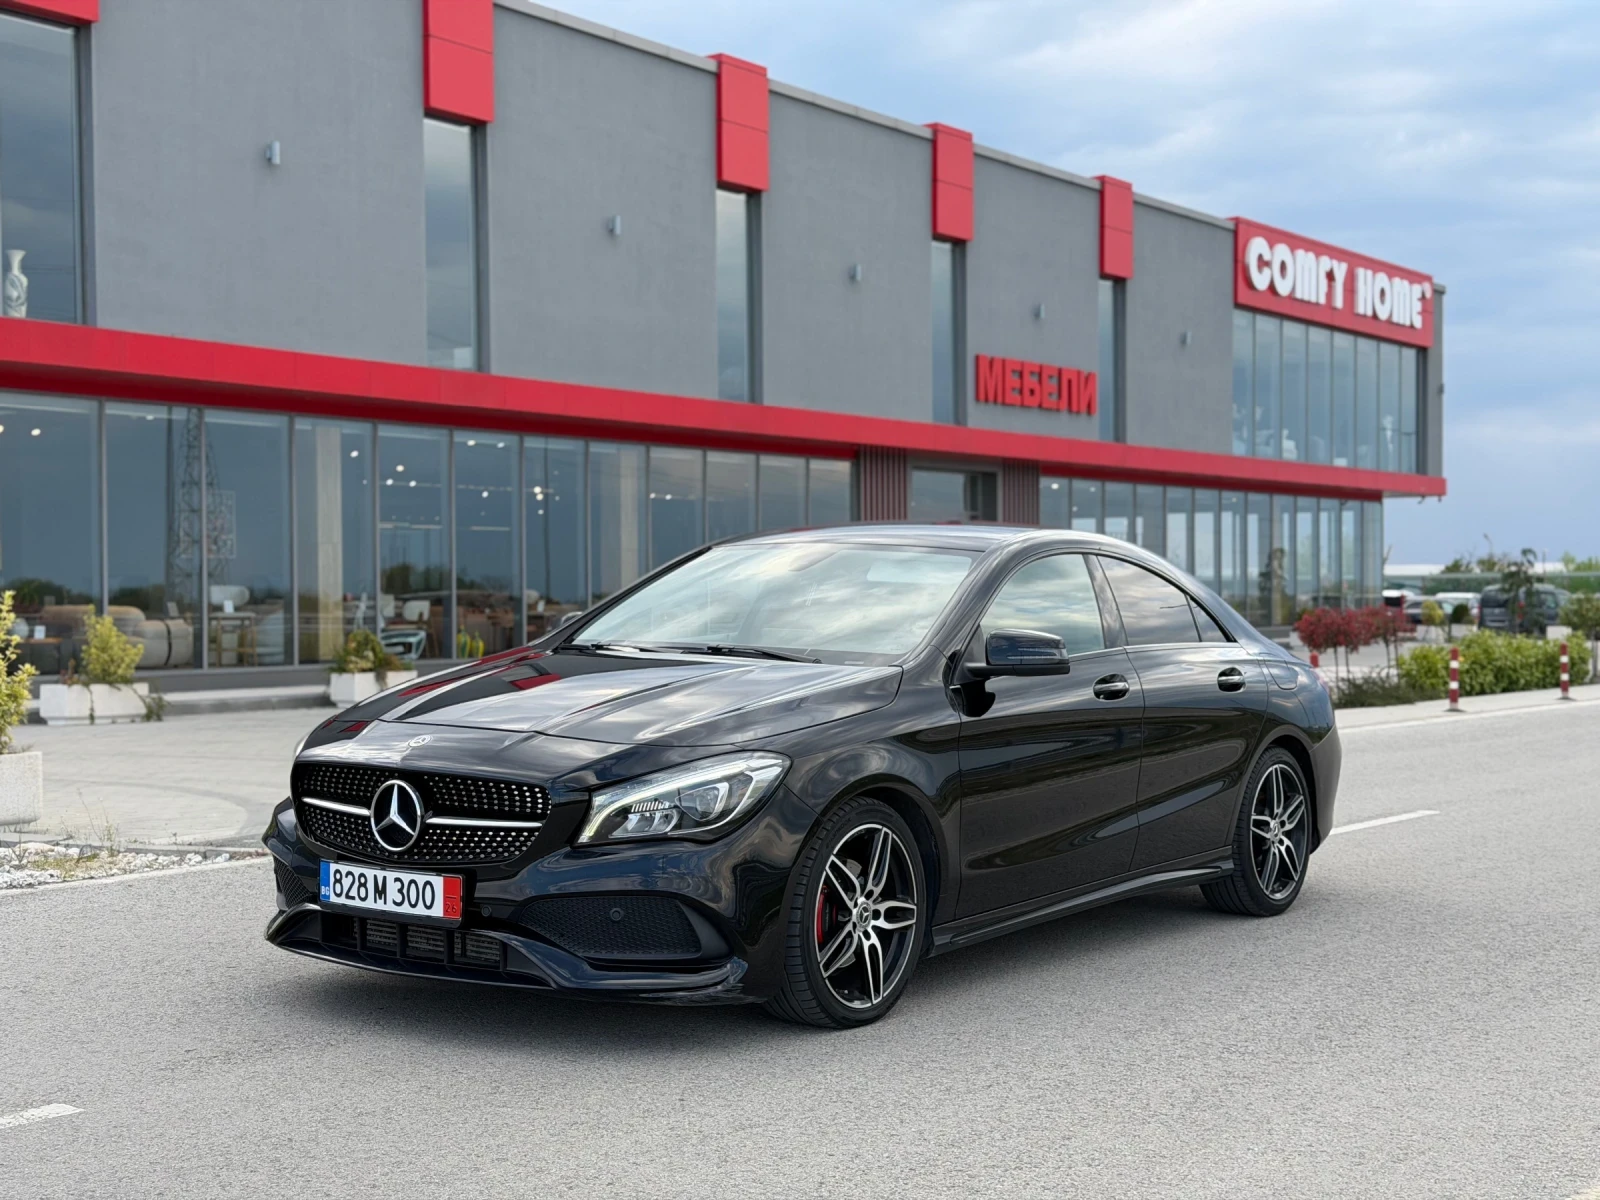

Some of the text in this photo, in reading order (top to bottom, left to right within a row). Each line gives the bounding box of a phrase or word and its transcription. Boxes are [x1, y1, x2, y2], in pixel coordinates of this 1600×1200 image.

[1245, 236, 1423, 329] COMFY HOME
[975, 353, 1097, 416] МЕБЕЛИ
[321, 885, 330, 896] BG
[333, 869, 436, 910] 828 M 300
[445, 903, 457, 914] 26
